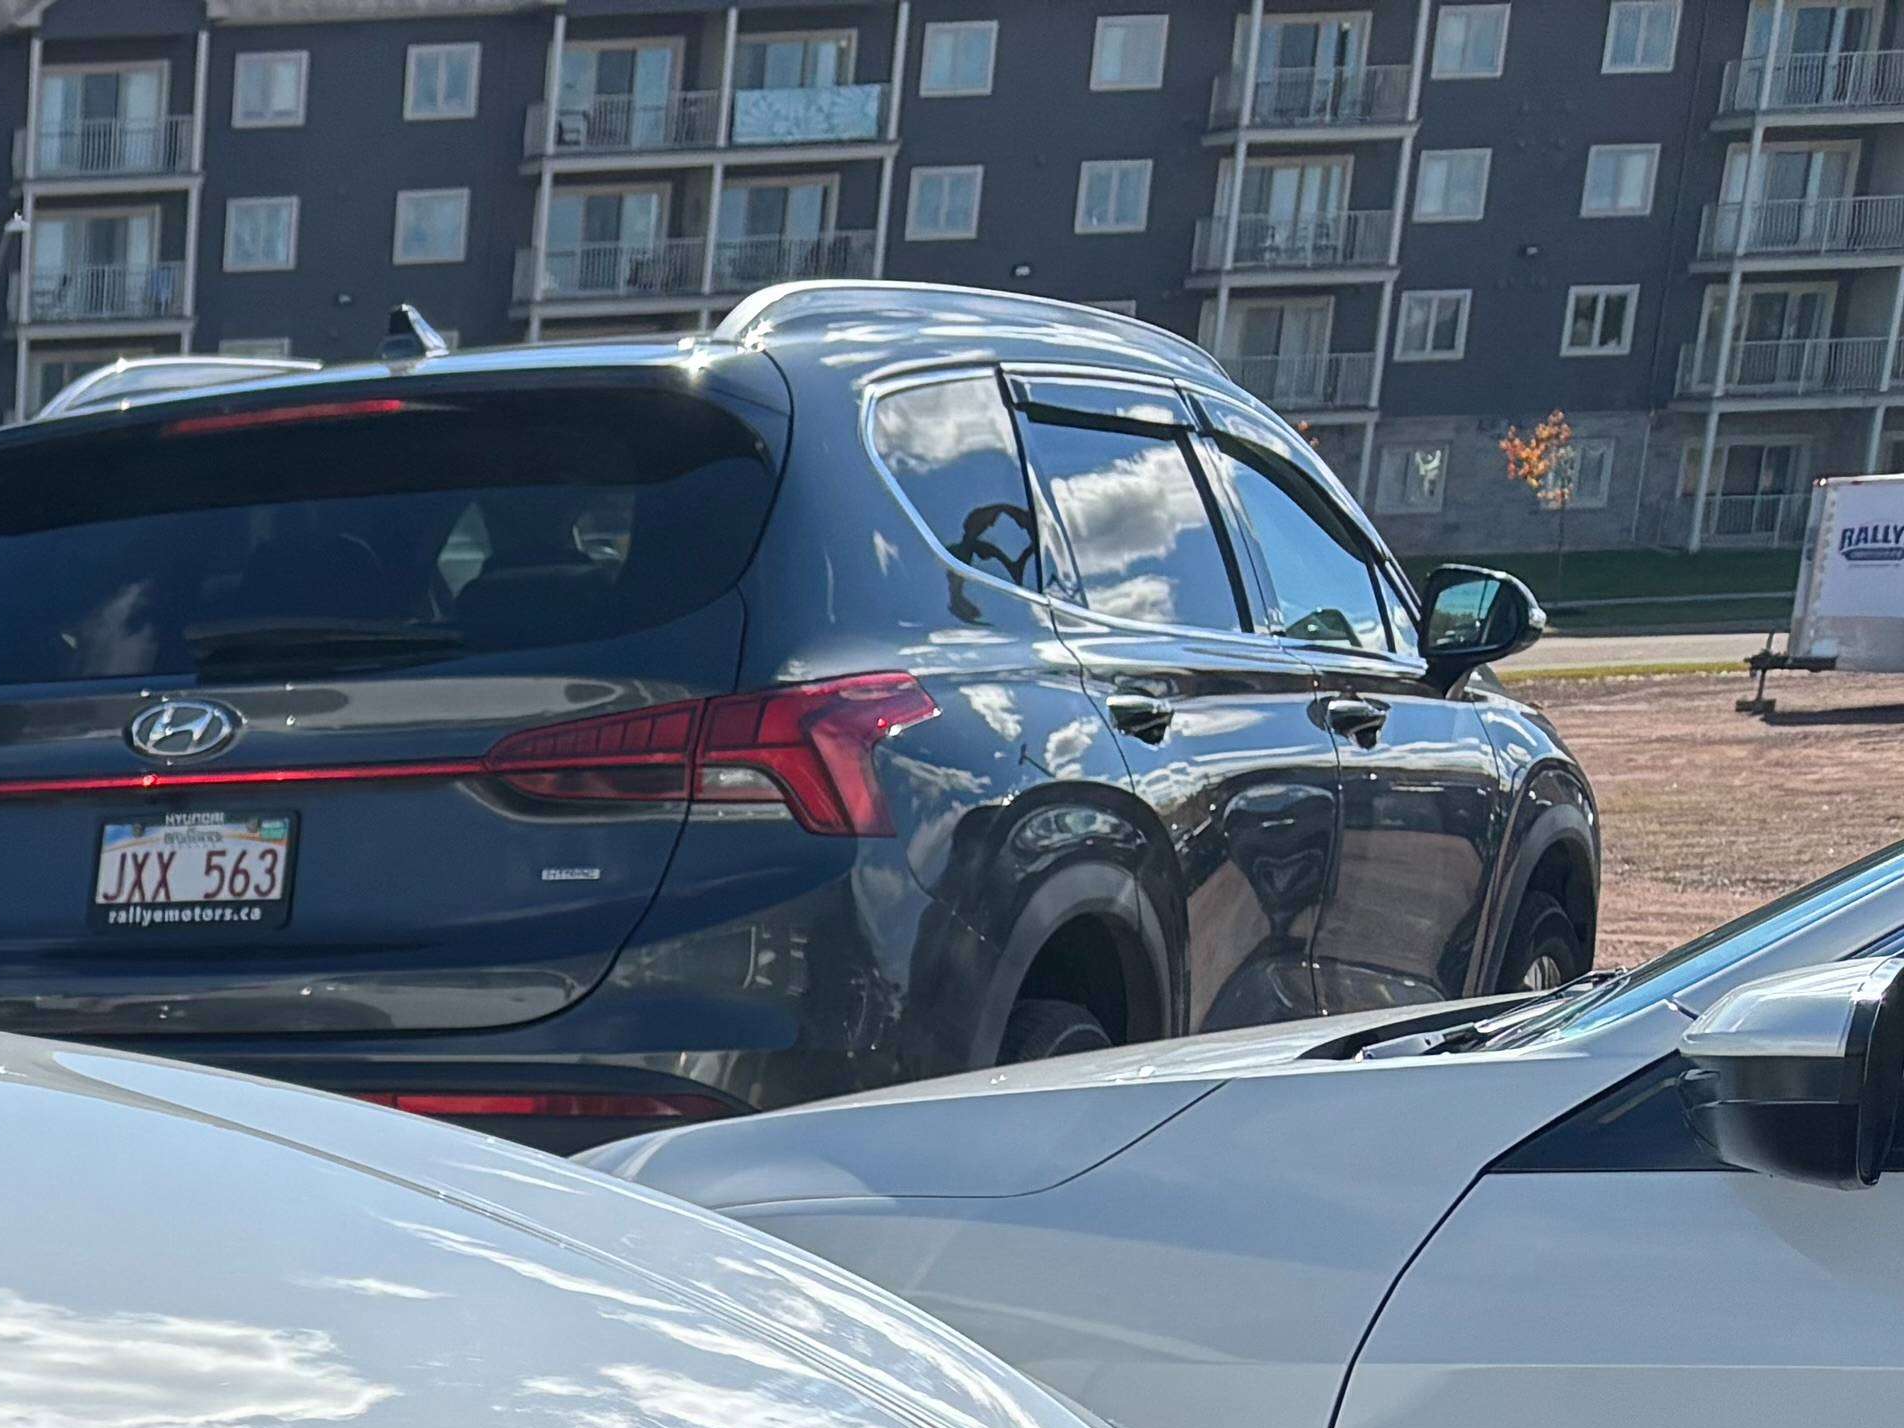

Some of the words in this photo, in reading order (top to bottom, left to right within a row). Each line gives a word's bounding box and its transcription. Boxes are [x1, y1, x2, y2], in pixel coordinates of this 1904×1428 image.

[1840, 525, 1904, 550] RALLY
[165, 812, 224, 826] HYUNDAI
[102, 851, 176, 902] JXX
[204, 849, 279, 899] 563
[108, 905, 262, 927] rallyemotors.ca
